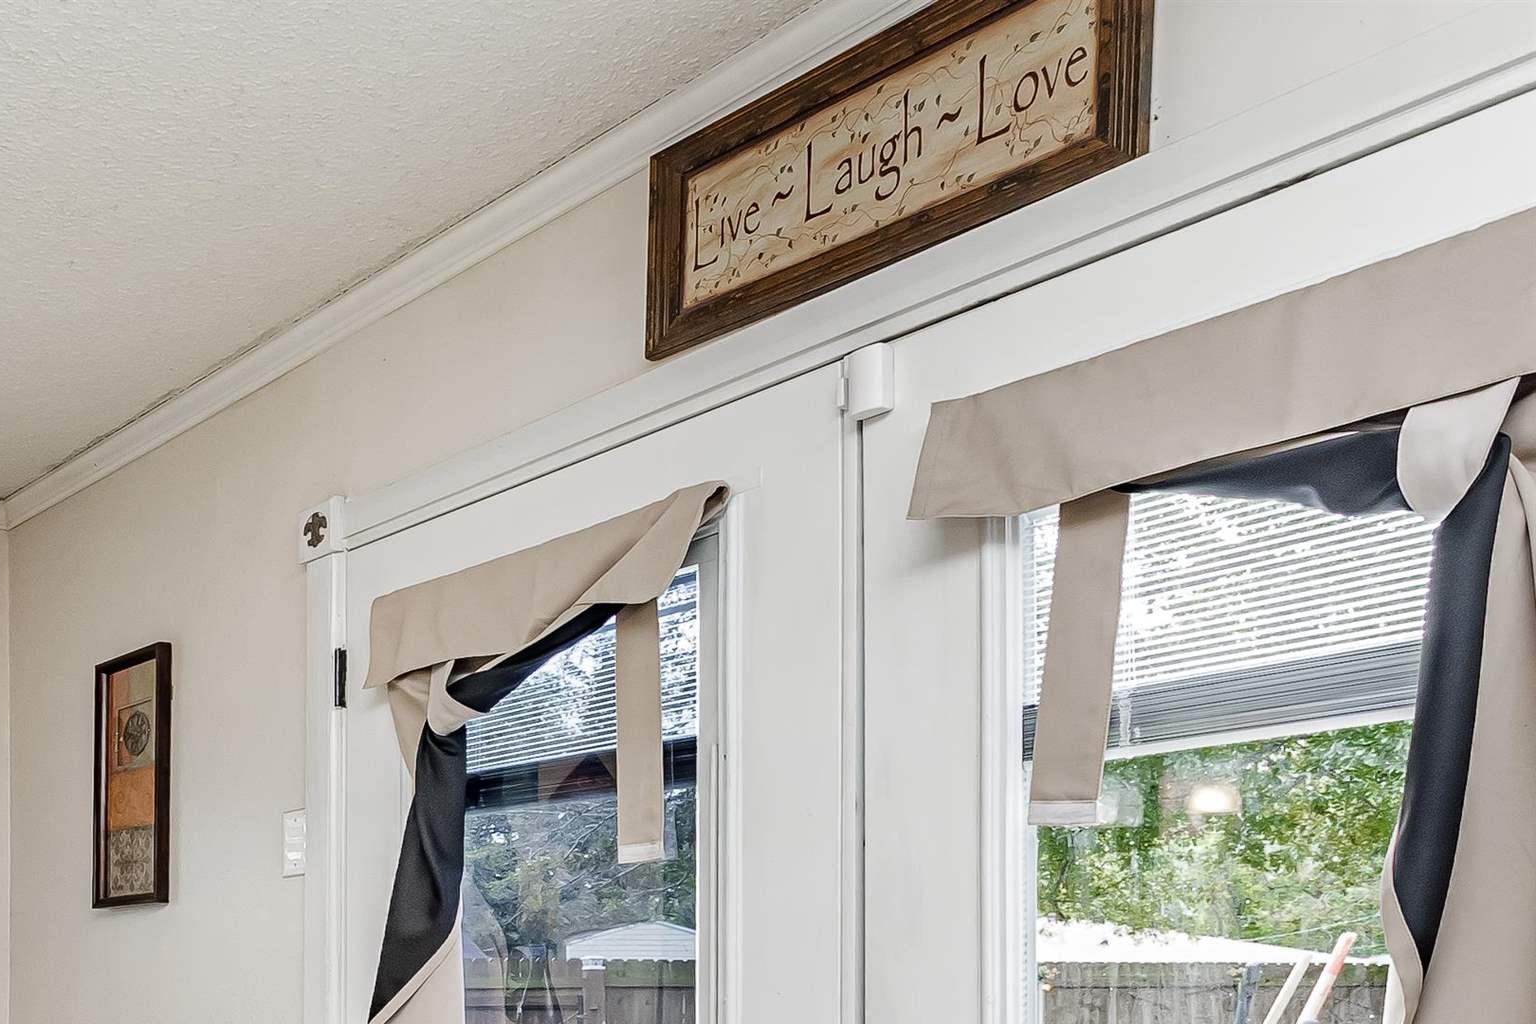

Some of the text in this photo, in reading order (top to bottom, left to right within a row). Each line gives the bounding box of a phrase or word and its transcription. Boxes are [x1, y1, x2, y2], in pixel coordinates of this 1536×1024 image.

[693, 197, 761, 272] Live
[804, 89, 923, 223] Laugh
[975, 44, 1089, 146] Love
